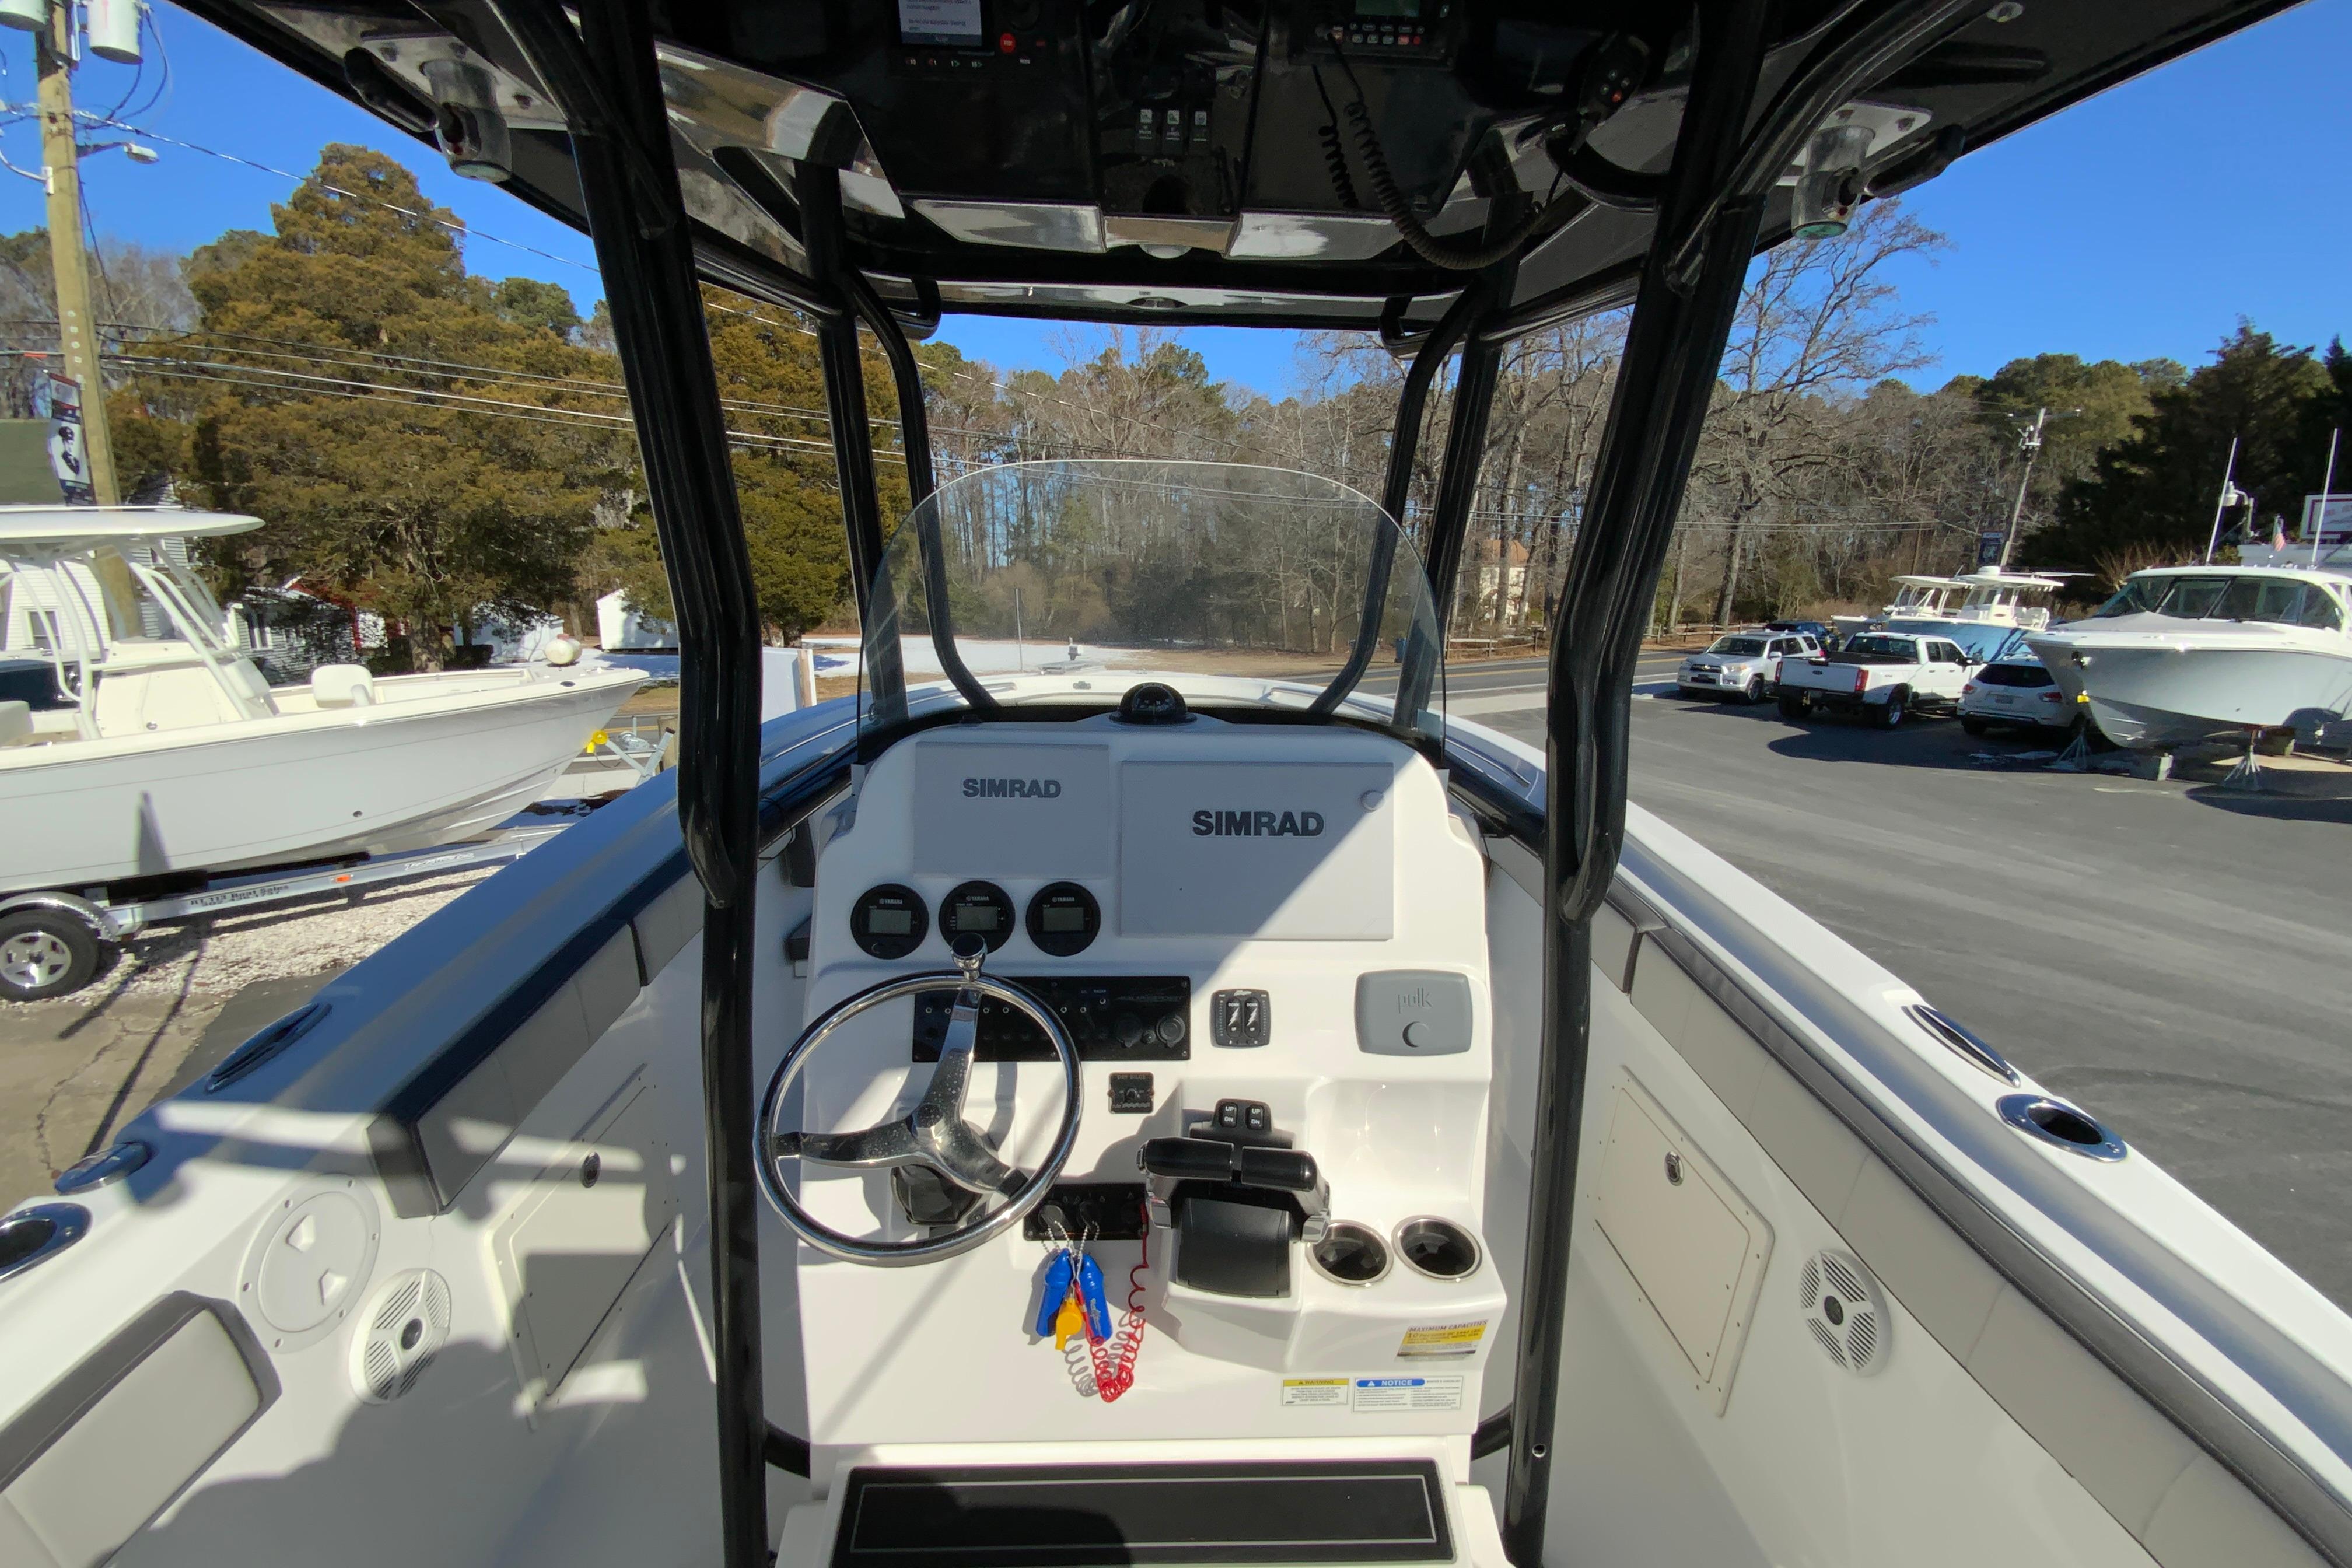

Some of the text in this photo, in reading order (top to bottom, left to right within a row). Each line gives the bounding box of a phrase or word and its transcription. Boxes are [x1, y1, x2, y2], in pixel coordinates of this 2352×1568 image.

[963, 778, 1061, 799] SIMRAD
[1192, 810, 1325, 838] SIMRAD
[1397, 987, 1433, 1013] polk
[1448, 1320, 1488, 1329] CAPACITIES
